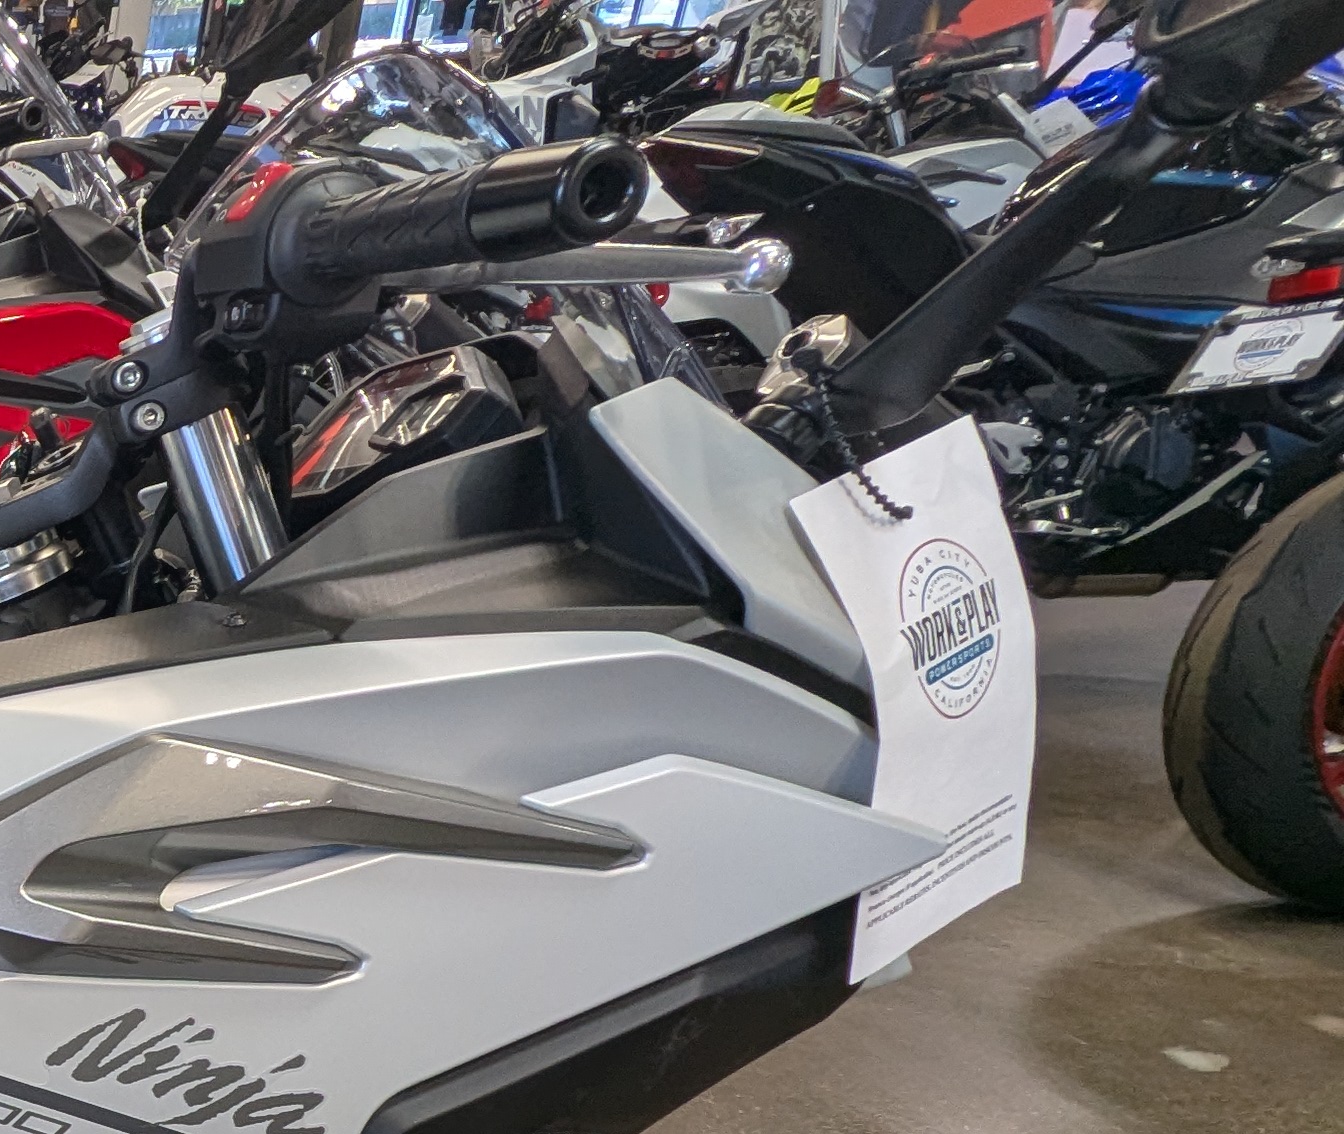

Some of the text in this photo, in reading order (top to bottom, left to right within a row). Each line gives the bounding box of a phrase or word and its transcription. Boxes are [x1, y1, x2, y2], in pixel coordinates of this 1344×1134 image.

[908, 555, 933, 599] YUBA
[928, 638, 993, 681] POWERSPORTS
[934, 658, 993, 709] CALIFORNIA
